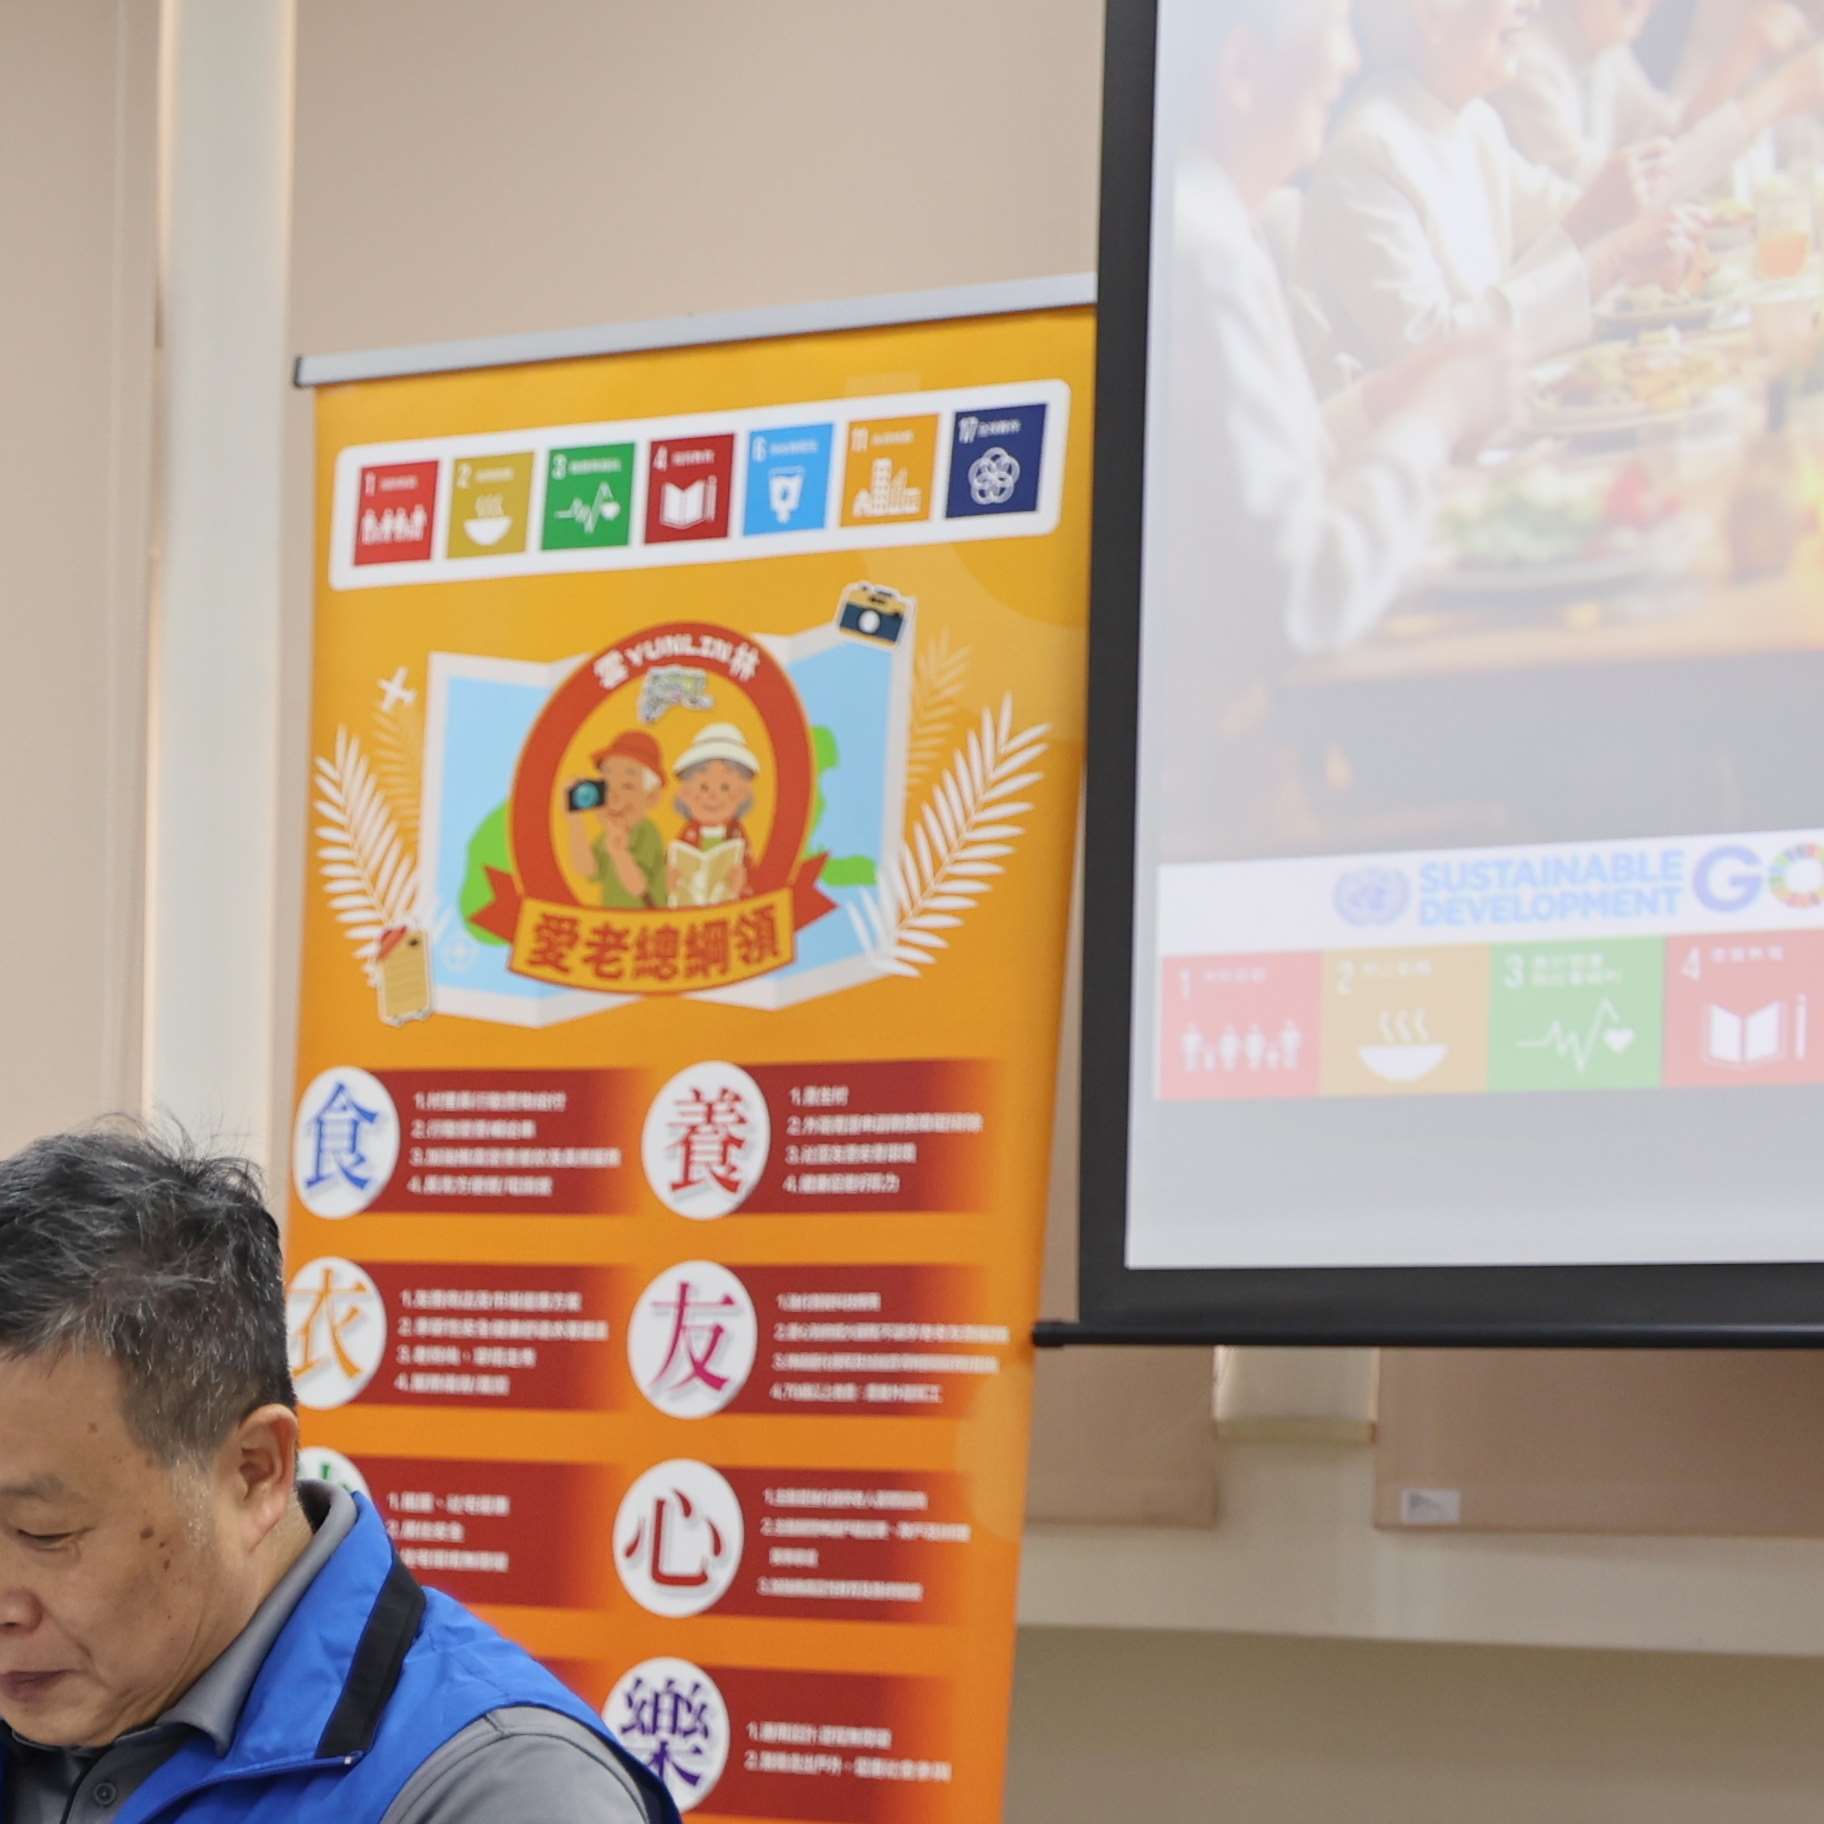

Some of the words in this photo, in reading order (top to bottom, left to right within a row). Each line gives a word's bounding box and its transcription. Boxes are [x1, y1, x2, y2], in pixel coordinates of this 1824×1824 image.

[457, 464, 472, 489] 2
[552, 454, 567, 480] 3
[653, 446, 667, 472] 4
[1418, 849, 1685, 893] SUSTAINABLE
[1418, 886, 1684, 928] DEVELOPMENT
[526, 903, 780, 981] 愛老總綱領
[1504, 953, 1524, 988] 3
[304, 1079, 378, 1190] 食
[666, 1087, 748, 1193] 養
[286, 1268, 366, 1379] 衣
[650, 1281, 735, 1391] 友
[624, 1487, 722, 1587] 心
[621, 1677, 709, 1787] 樂
